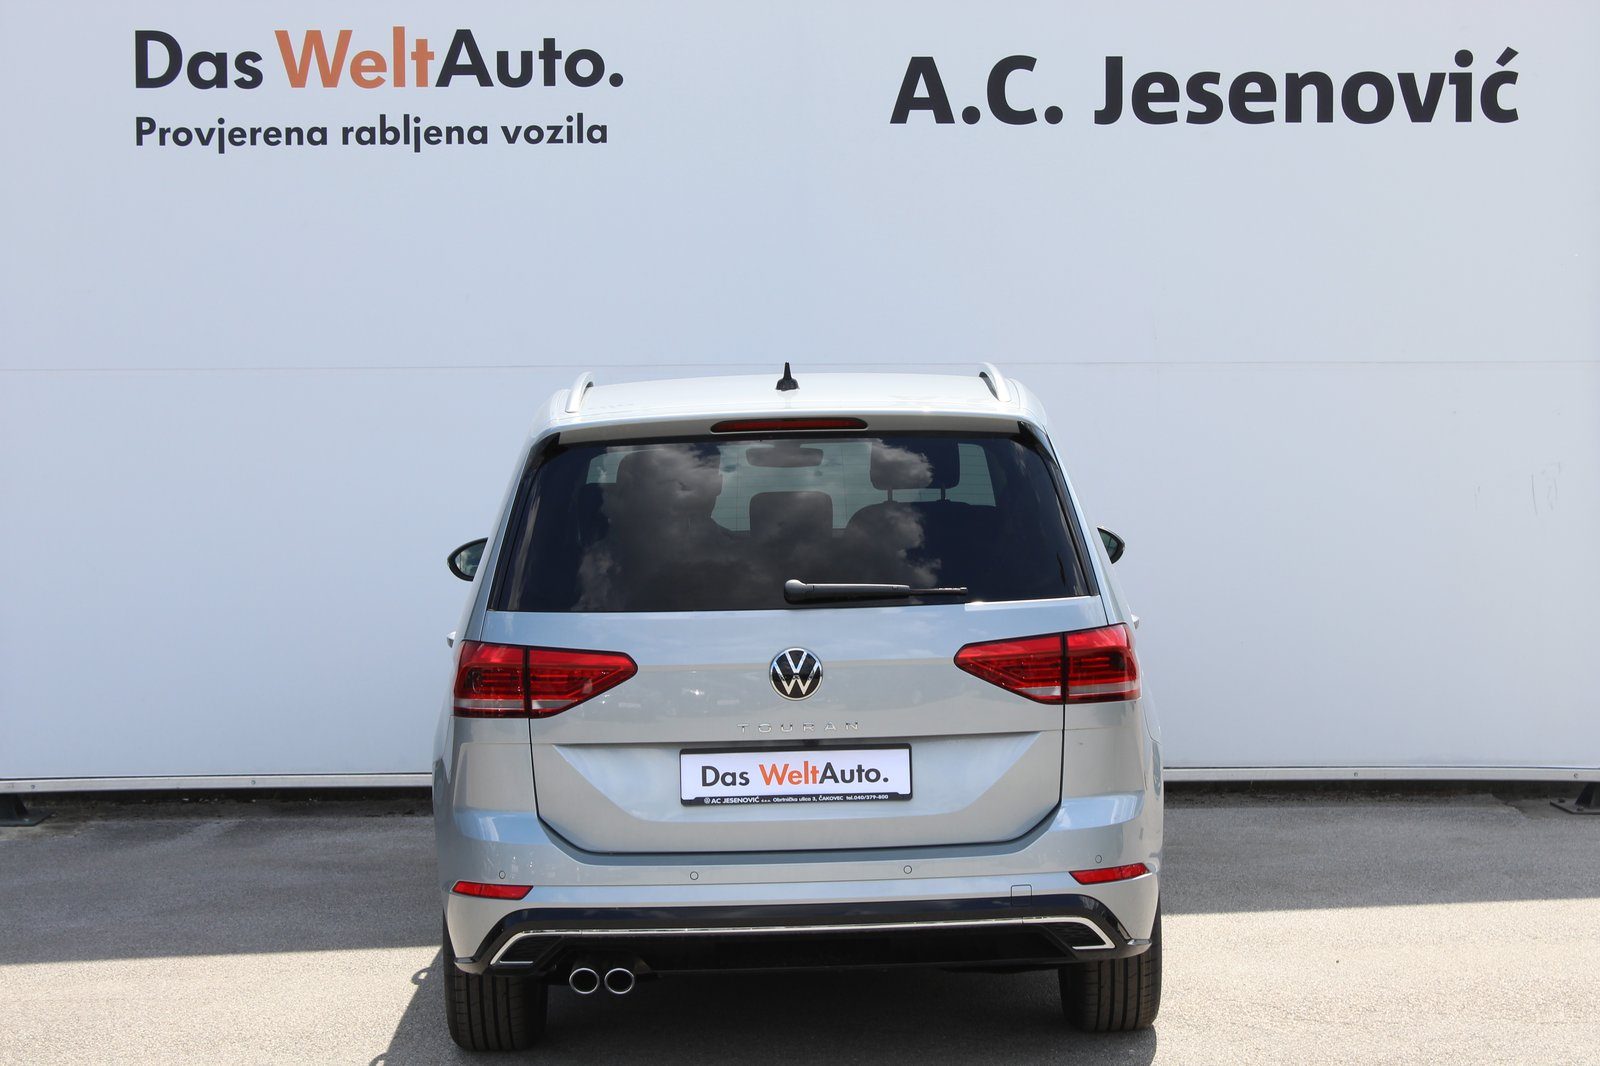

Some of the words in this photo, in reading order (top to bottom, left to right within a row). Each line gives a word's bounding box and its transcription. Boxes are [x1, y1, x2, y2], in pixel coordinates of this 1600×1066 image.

[135, 30, 263, 90] Das
[274, 26, 623, 89] WeltAuto.
[890, 55, 1063, 125] A.C.
[1094, 47, 1518, 125] Jesenović
[136, 117, 327, 154] Provjerena
[342, 114, 487, 153] rabljena
[501, 113, 607, 145] vozila
[737, 722, 859, 733] TOURAN
[701, 766, 750, 787] Das
[759, 761, 889, 785] WeltAuto.
[723, 796, 759, 804] JESENOVIĆ
